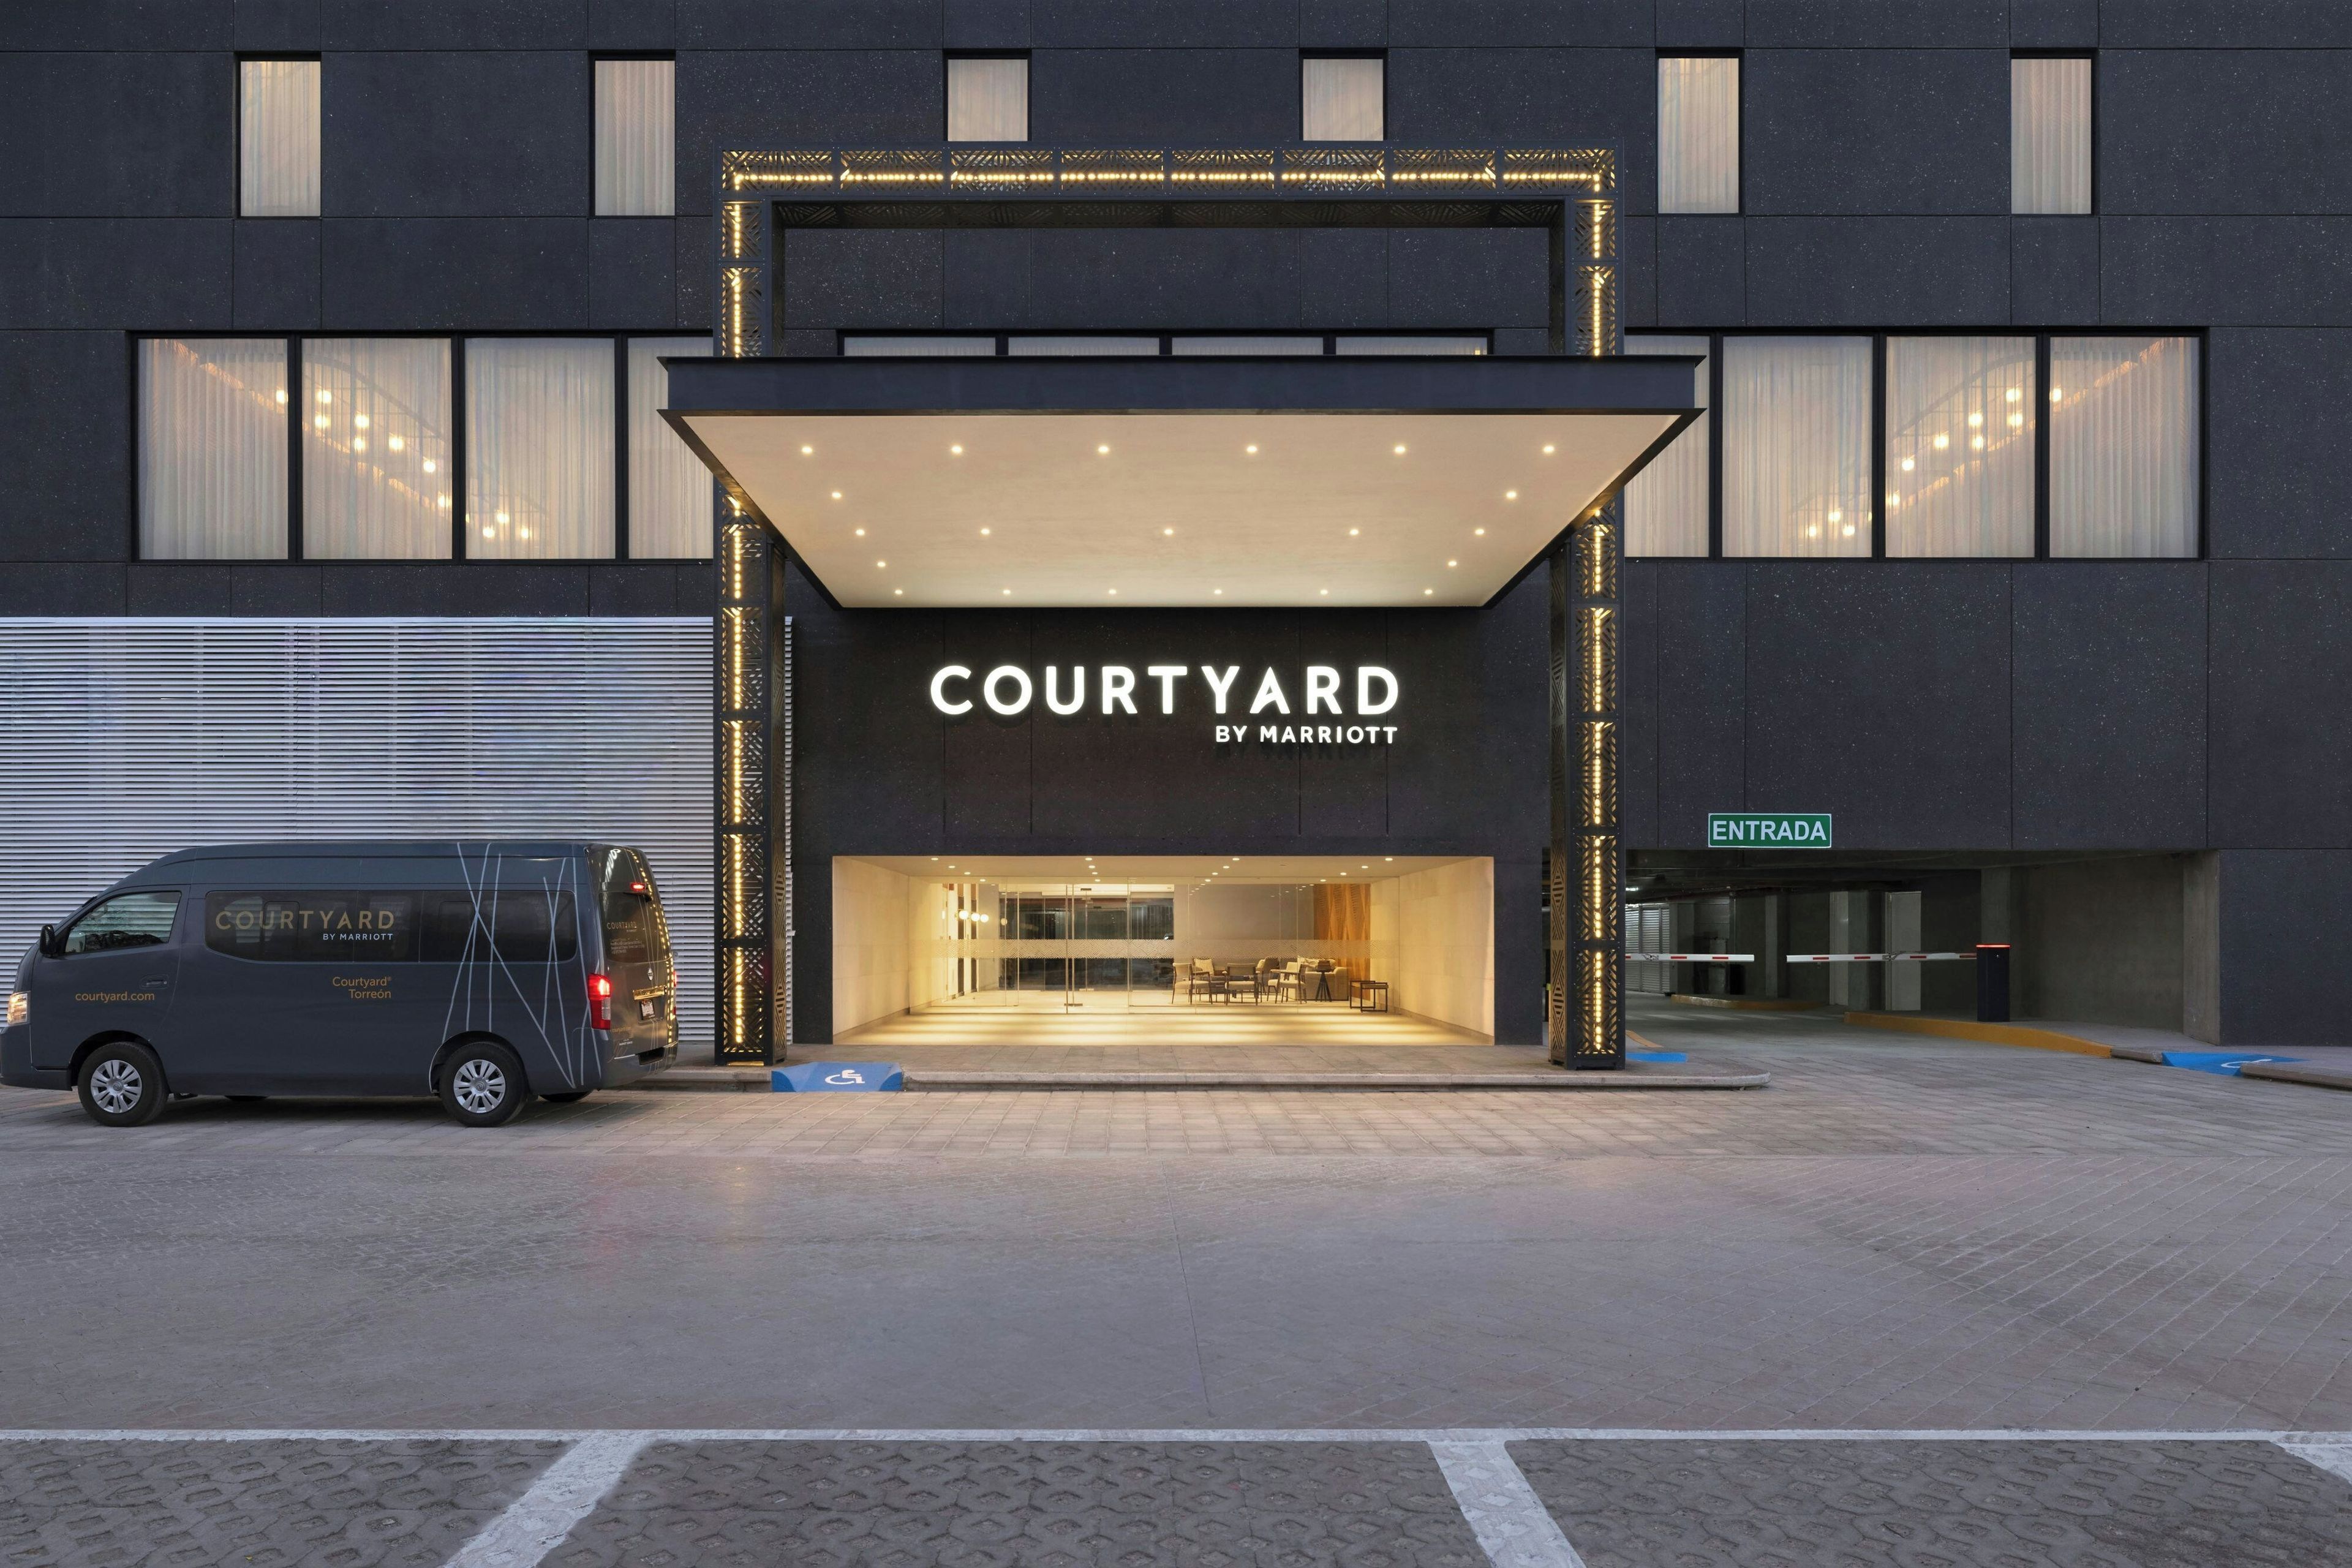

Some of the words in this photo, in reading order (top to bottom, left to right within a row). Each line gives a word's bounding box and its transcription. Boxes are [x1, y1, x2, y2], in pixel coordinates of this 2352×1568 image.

[930, 665, 1399, 716] COURTYARD
[1215, 725, 1248, 743] BY
[1259, 726, 1398, 744] MARRIOTT
[1713, 821, 1827, 840] ENTRADA
[216, 910, 394, 930] COURTYARD
[75, 991, 155, 1003] courtyard.com
[348, 989, 391, 998] Torreón
